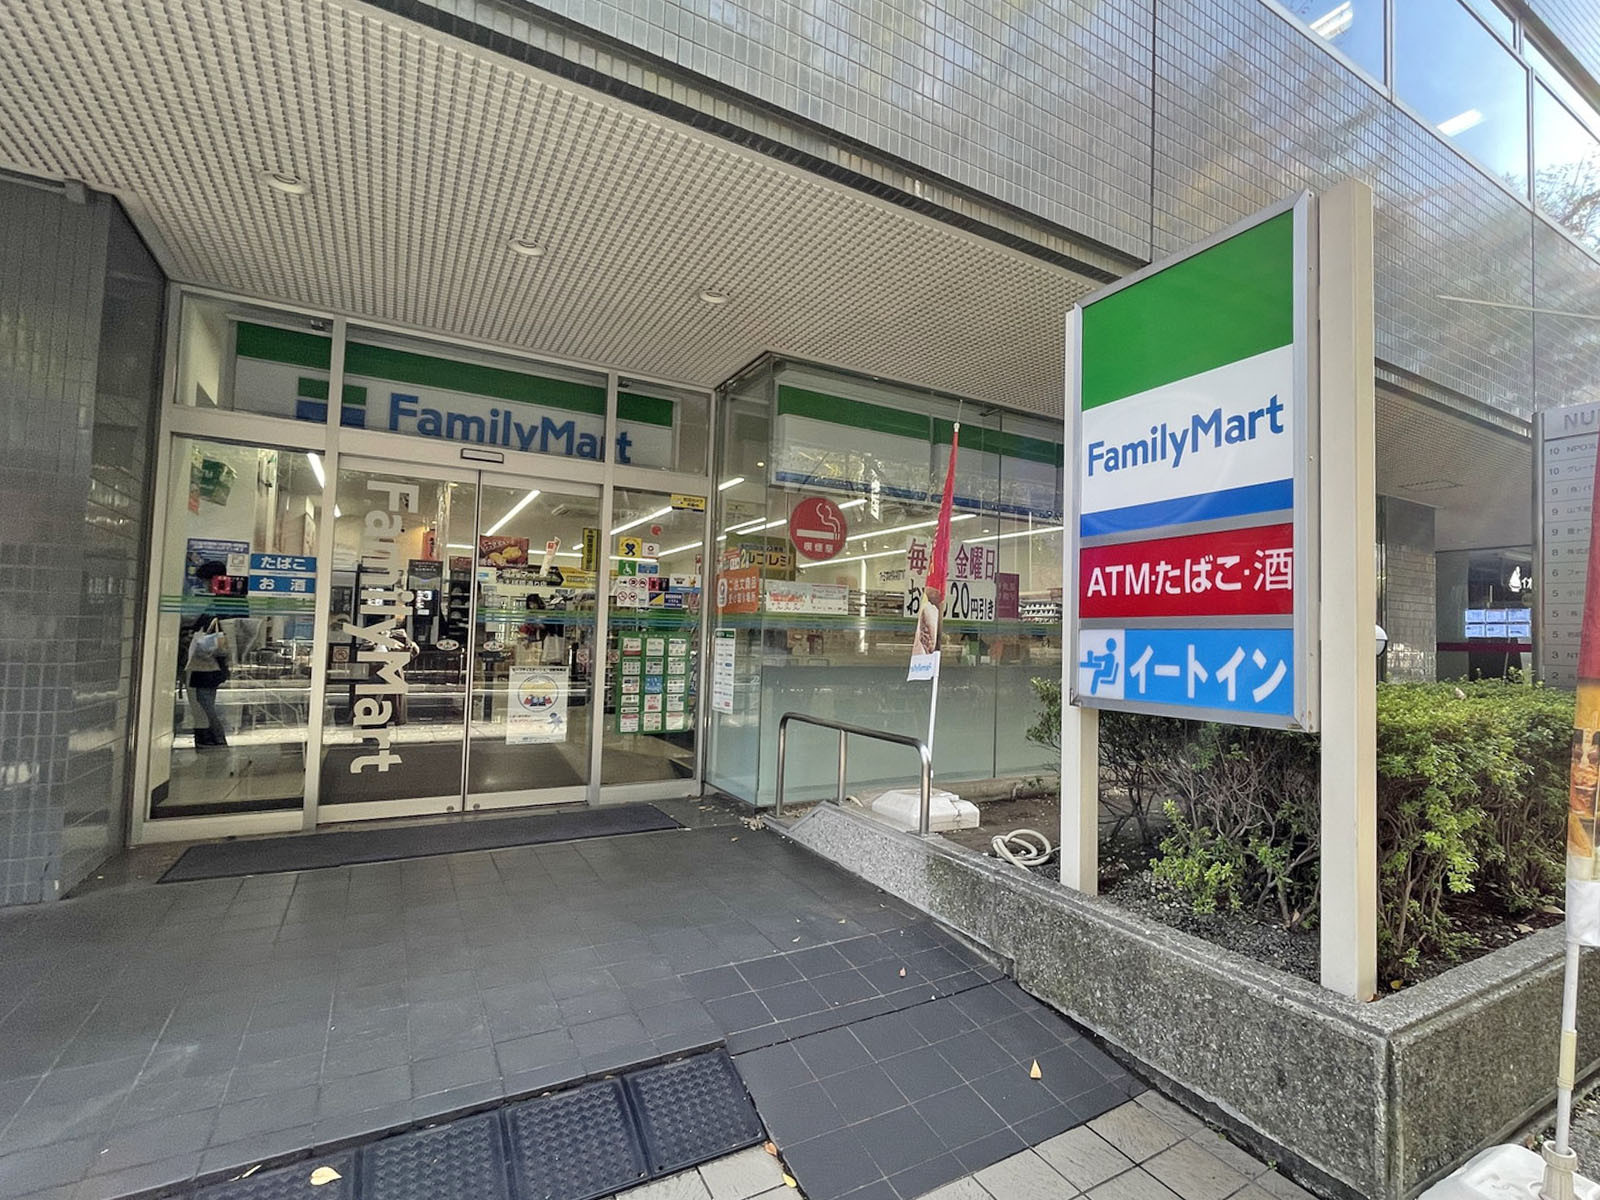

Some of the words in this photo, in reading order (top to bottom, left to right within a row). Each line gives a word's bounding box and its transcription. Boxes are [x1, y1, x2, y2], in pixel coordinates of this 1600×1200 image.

[1087, 394, 1284, 477] FamilyMart
[1564, 409, 1600, 430] NU
[1549, 447, 1560, 455] 10
[1548, 467, 1560, 475] 10
[260, 556, 306, 570] たばこ
[907, 537, 996, 580] 毎金曜日
[343, 480, 419, 774] FamilyMart
[1129, 643, 1288, 703] イートイン
